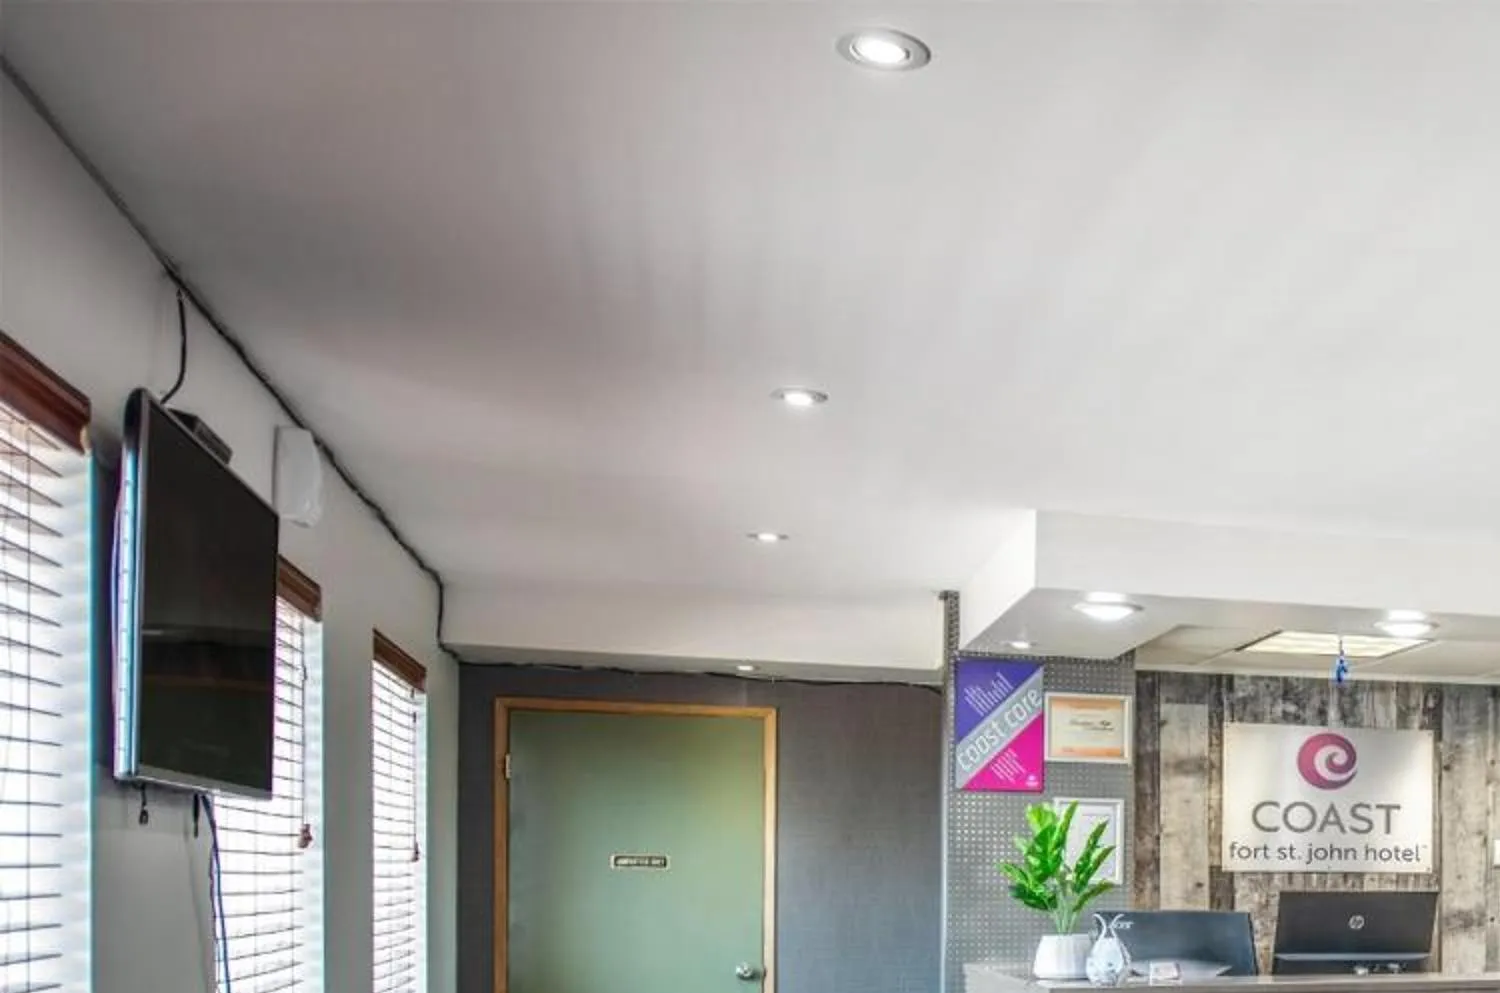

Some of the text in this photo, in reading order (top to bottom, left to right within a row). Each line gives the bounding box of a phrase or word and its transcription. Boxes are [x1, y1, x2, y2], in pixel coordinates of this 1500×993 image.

[957, 720, 1005, 772] coast
[1003, 689, 1042, 728] core
[1251, 800, 1402, 835] COAST
[1229, 841, 1421, 865] fort st. john hotel
